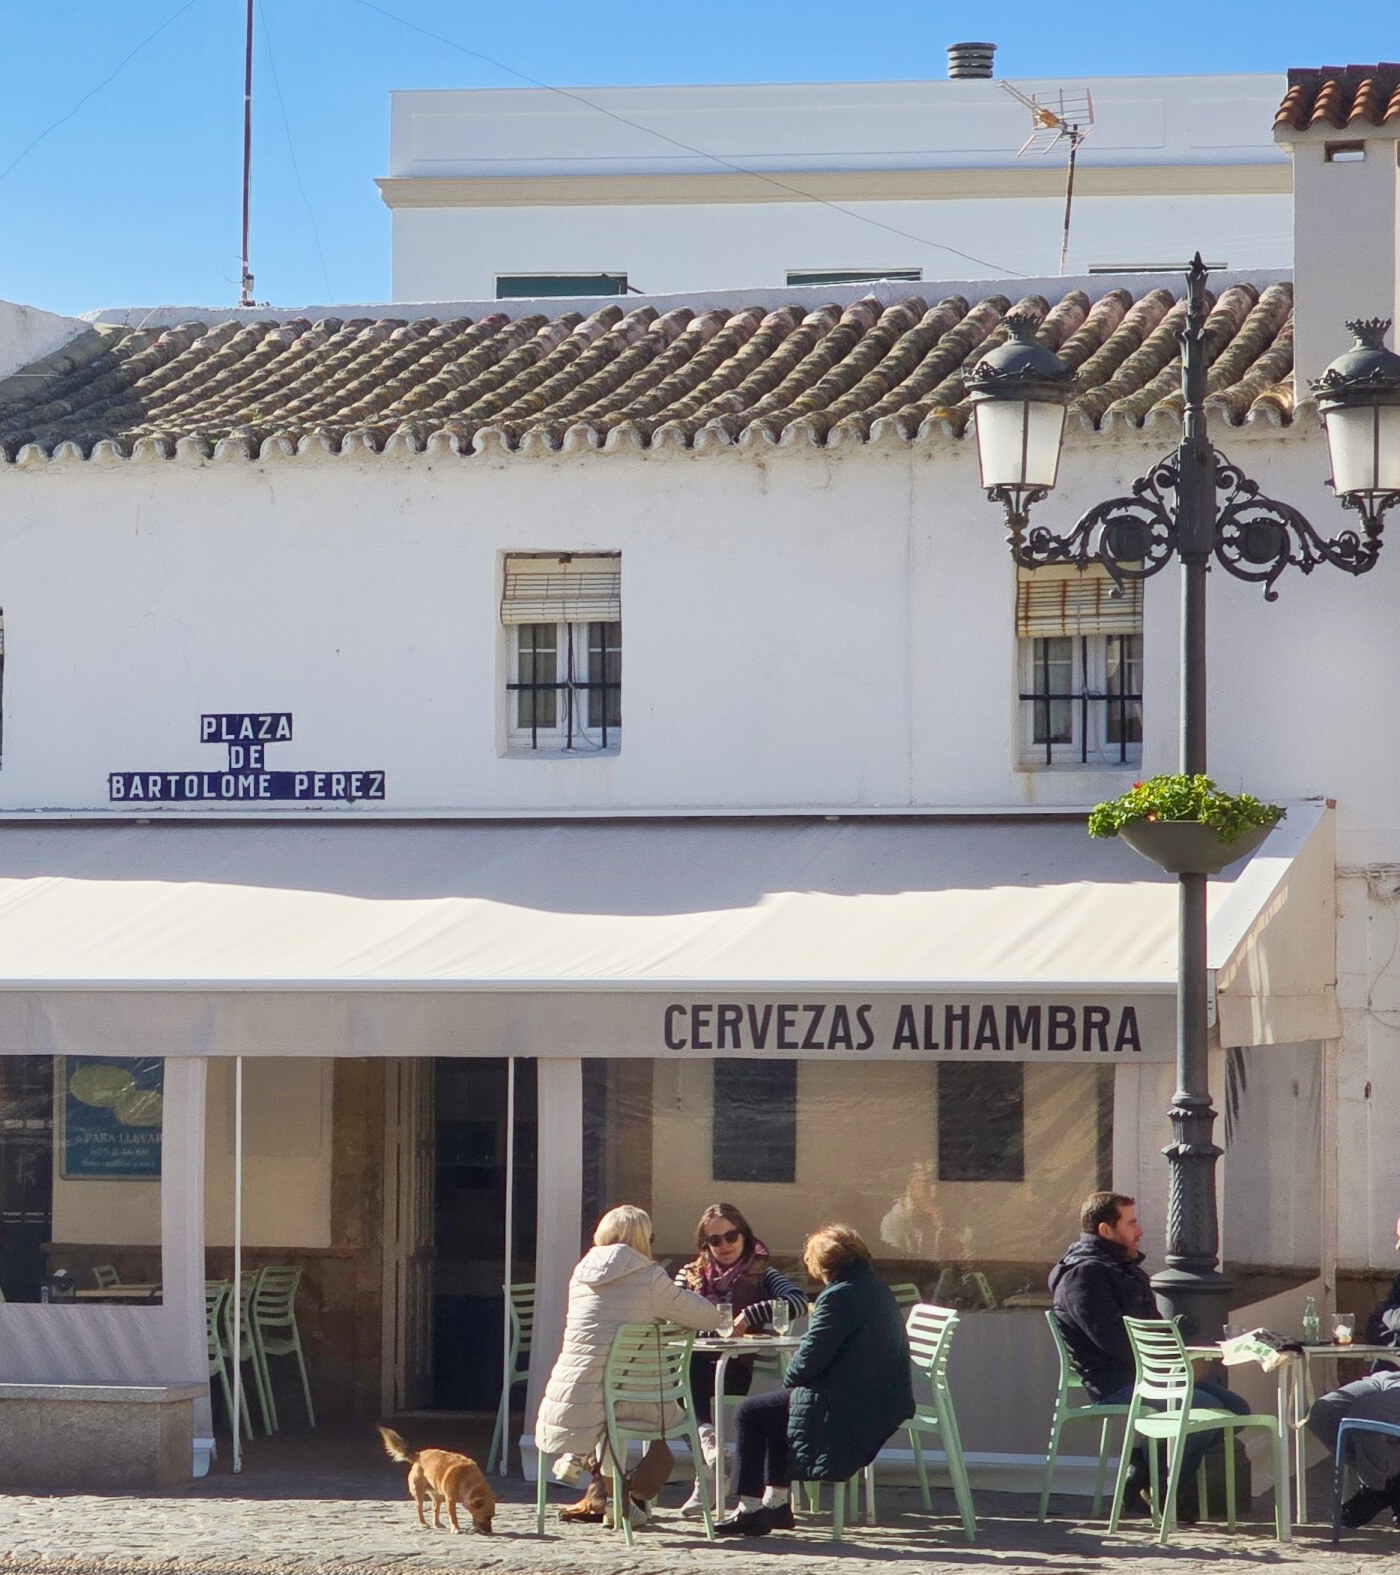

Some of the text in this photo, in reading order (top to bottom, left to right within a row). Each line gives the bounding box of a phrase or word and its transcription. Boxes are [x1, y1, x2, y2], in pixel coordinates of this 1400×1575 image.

[202, 715, 291, 740] PLAZA
[230, 745, 262, 769] DE
[111, 773, 383, 799] BARTOLOME PEREZ
[664, 1003, 1142, 1052] CERVEZAS ALHAMBRA
